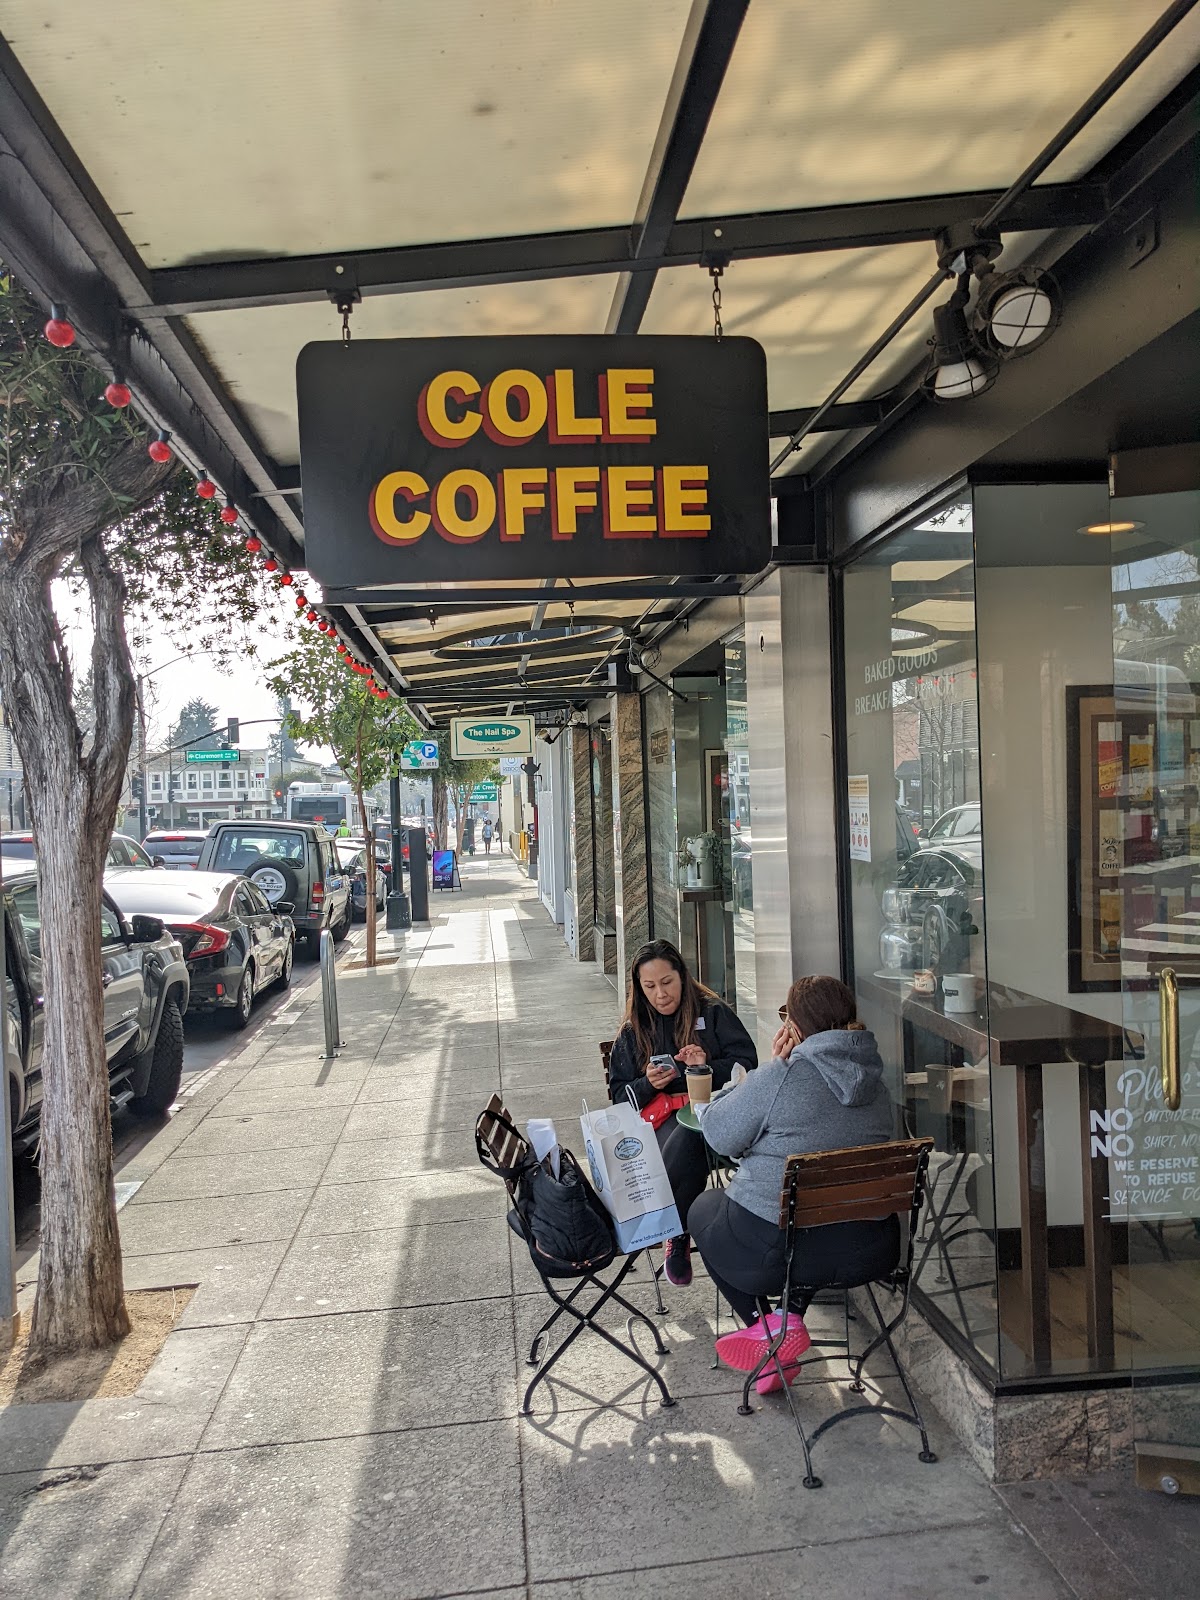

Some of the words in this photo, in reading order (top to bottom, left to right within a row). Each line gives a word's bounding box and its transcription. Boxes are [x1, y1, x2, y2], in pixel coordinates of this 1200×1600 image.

[418, 368, 657, 448] COLE
[368, 465, 711, 546] COFFEE
[864, 657, 896, 684] BAKED
[897, 650, 938, 674] GOODS
[467, 728, 483, 737] The
[484, 728, 500, 736] Nail
[501, 727, 516, 737] Spa
[424, 745, 435, 757] P
[1090, 1108, 1133, 1132] NO
[1144, 1108, 1189, 1123] OUTSIDE
[1090, 1133, 1134, 1158] NO
[1143, 1134, 1178, 1149] SHIRT,
[1114, 1160, 1135, 1172] WE
[1140, 1156, 1200, 1171] RESERVE
[1122, 1174, 1141, 1187] TO
[1148, 1171, 1196, 1186] REFUSE
[1112, 1187, 1175, 1206] SERVICE
